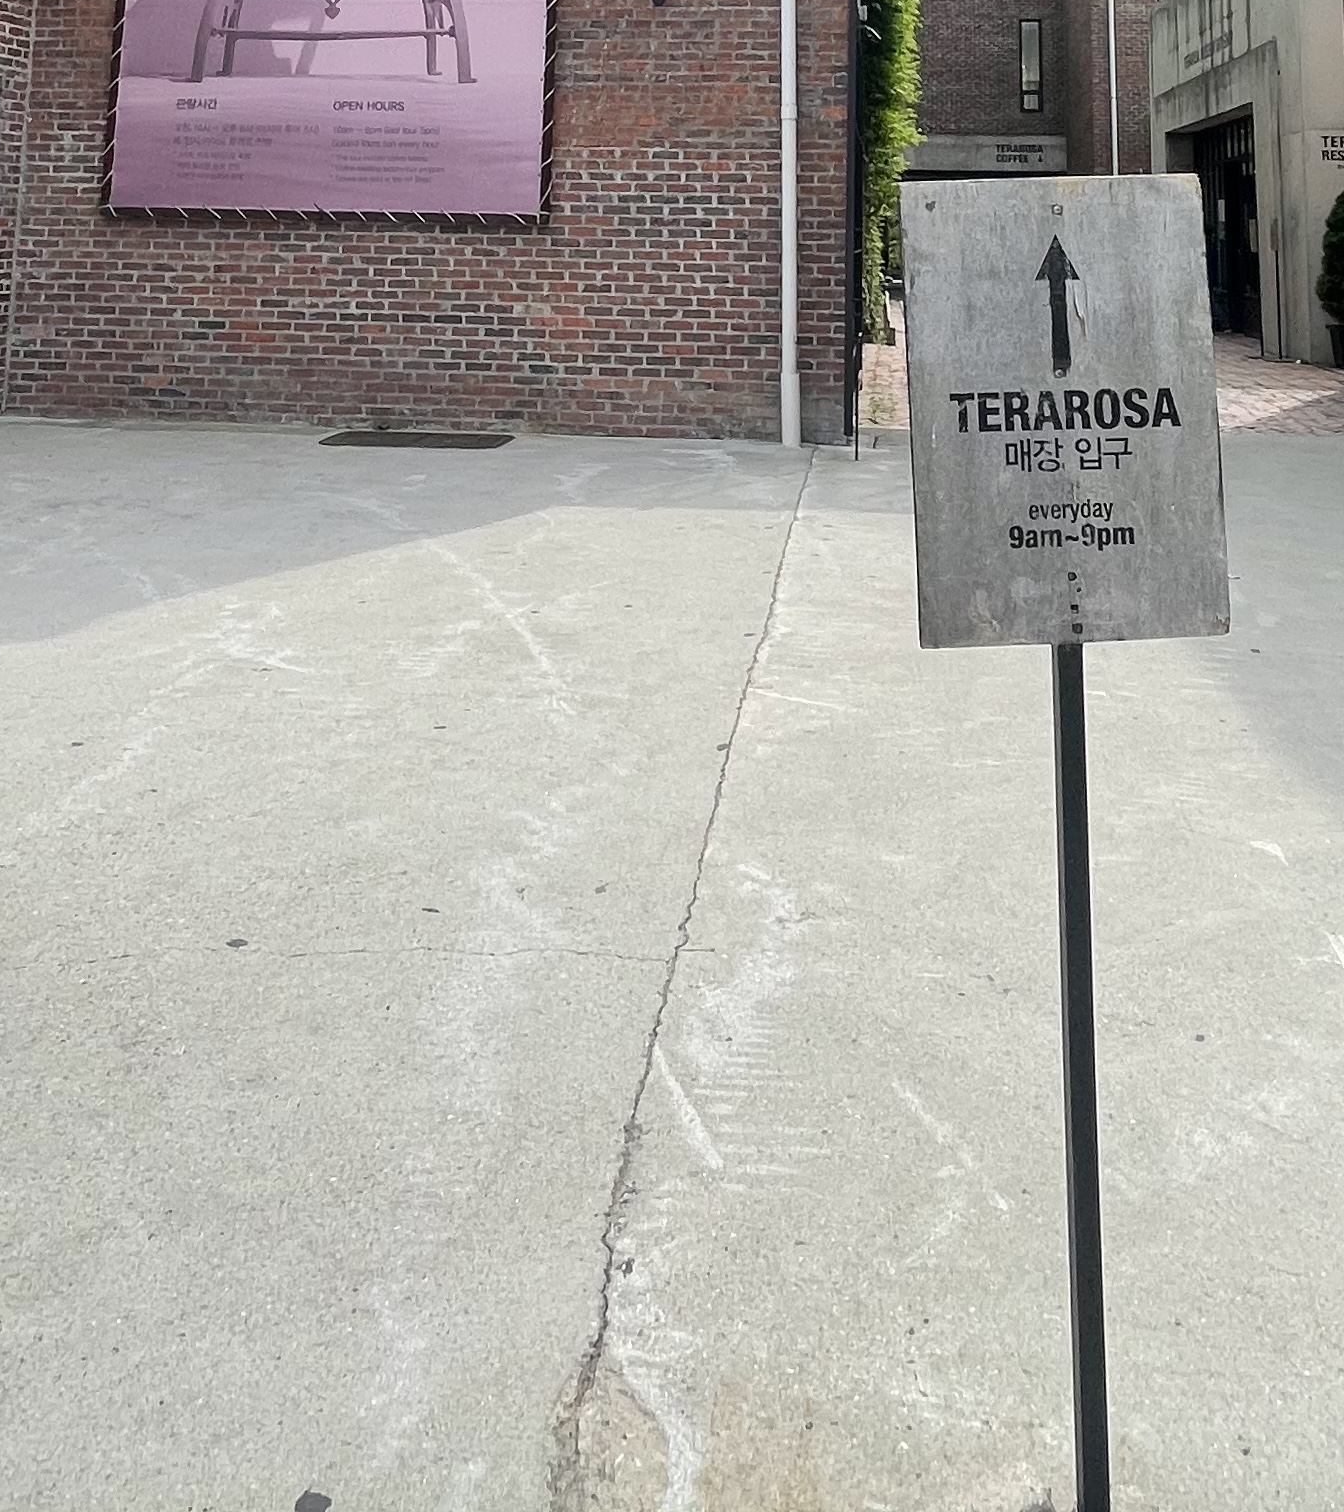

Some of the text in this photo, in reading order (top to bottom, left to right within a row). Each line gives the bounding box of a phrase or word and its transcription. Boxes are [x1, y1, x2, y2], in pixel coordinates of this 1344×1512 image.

[333, 101, 405, 111] OPEN HOURS
[996, 154, 1029, 163] COFFEE
[949, 388, 1182, 433] TERAROSA
[1005, 437, 1133, 473] 매장 입구
[1029, 499, 1113, 523] everyday
[1009, 523, 1135, 551] 9am~9pm
